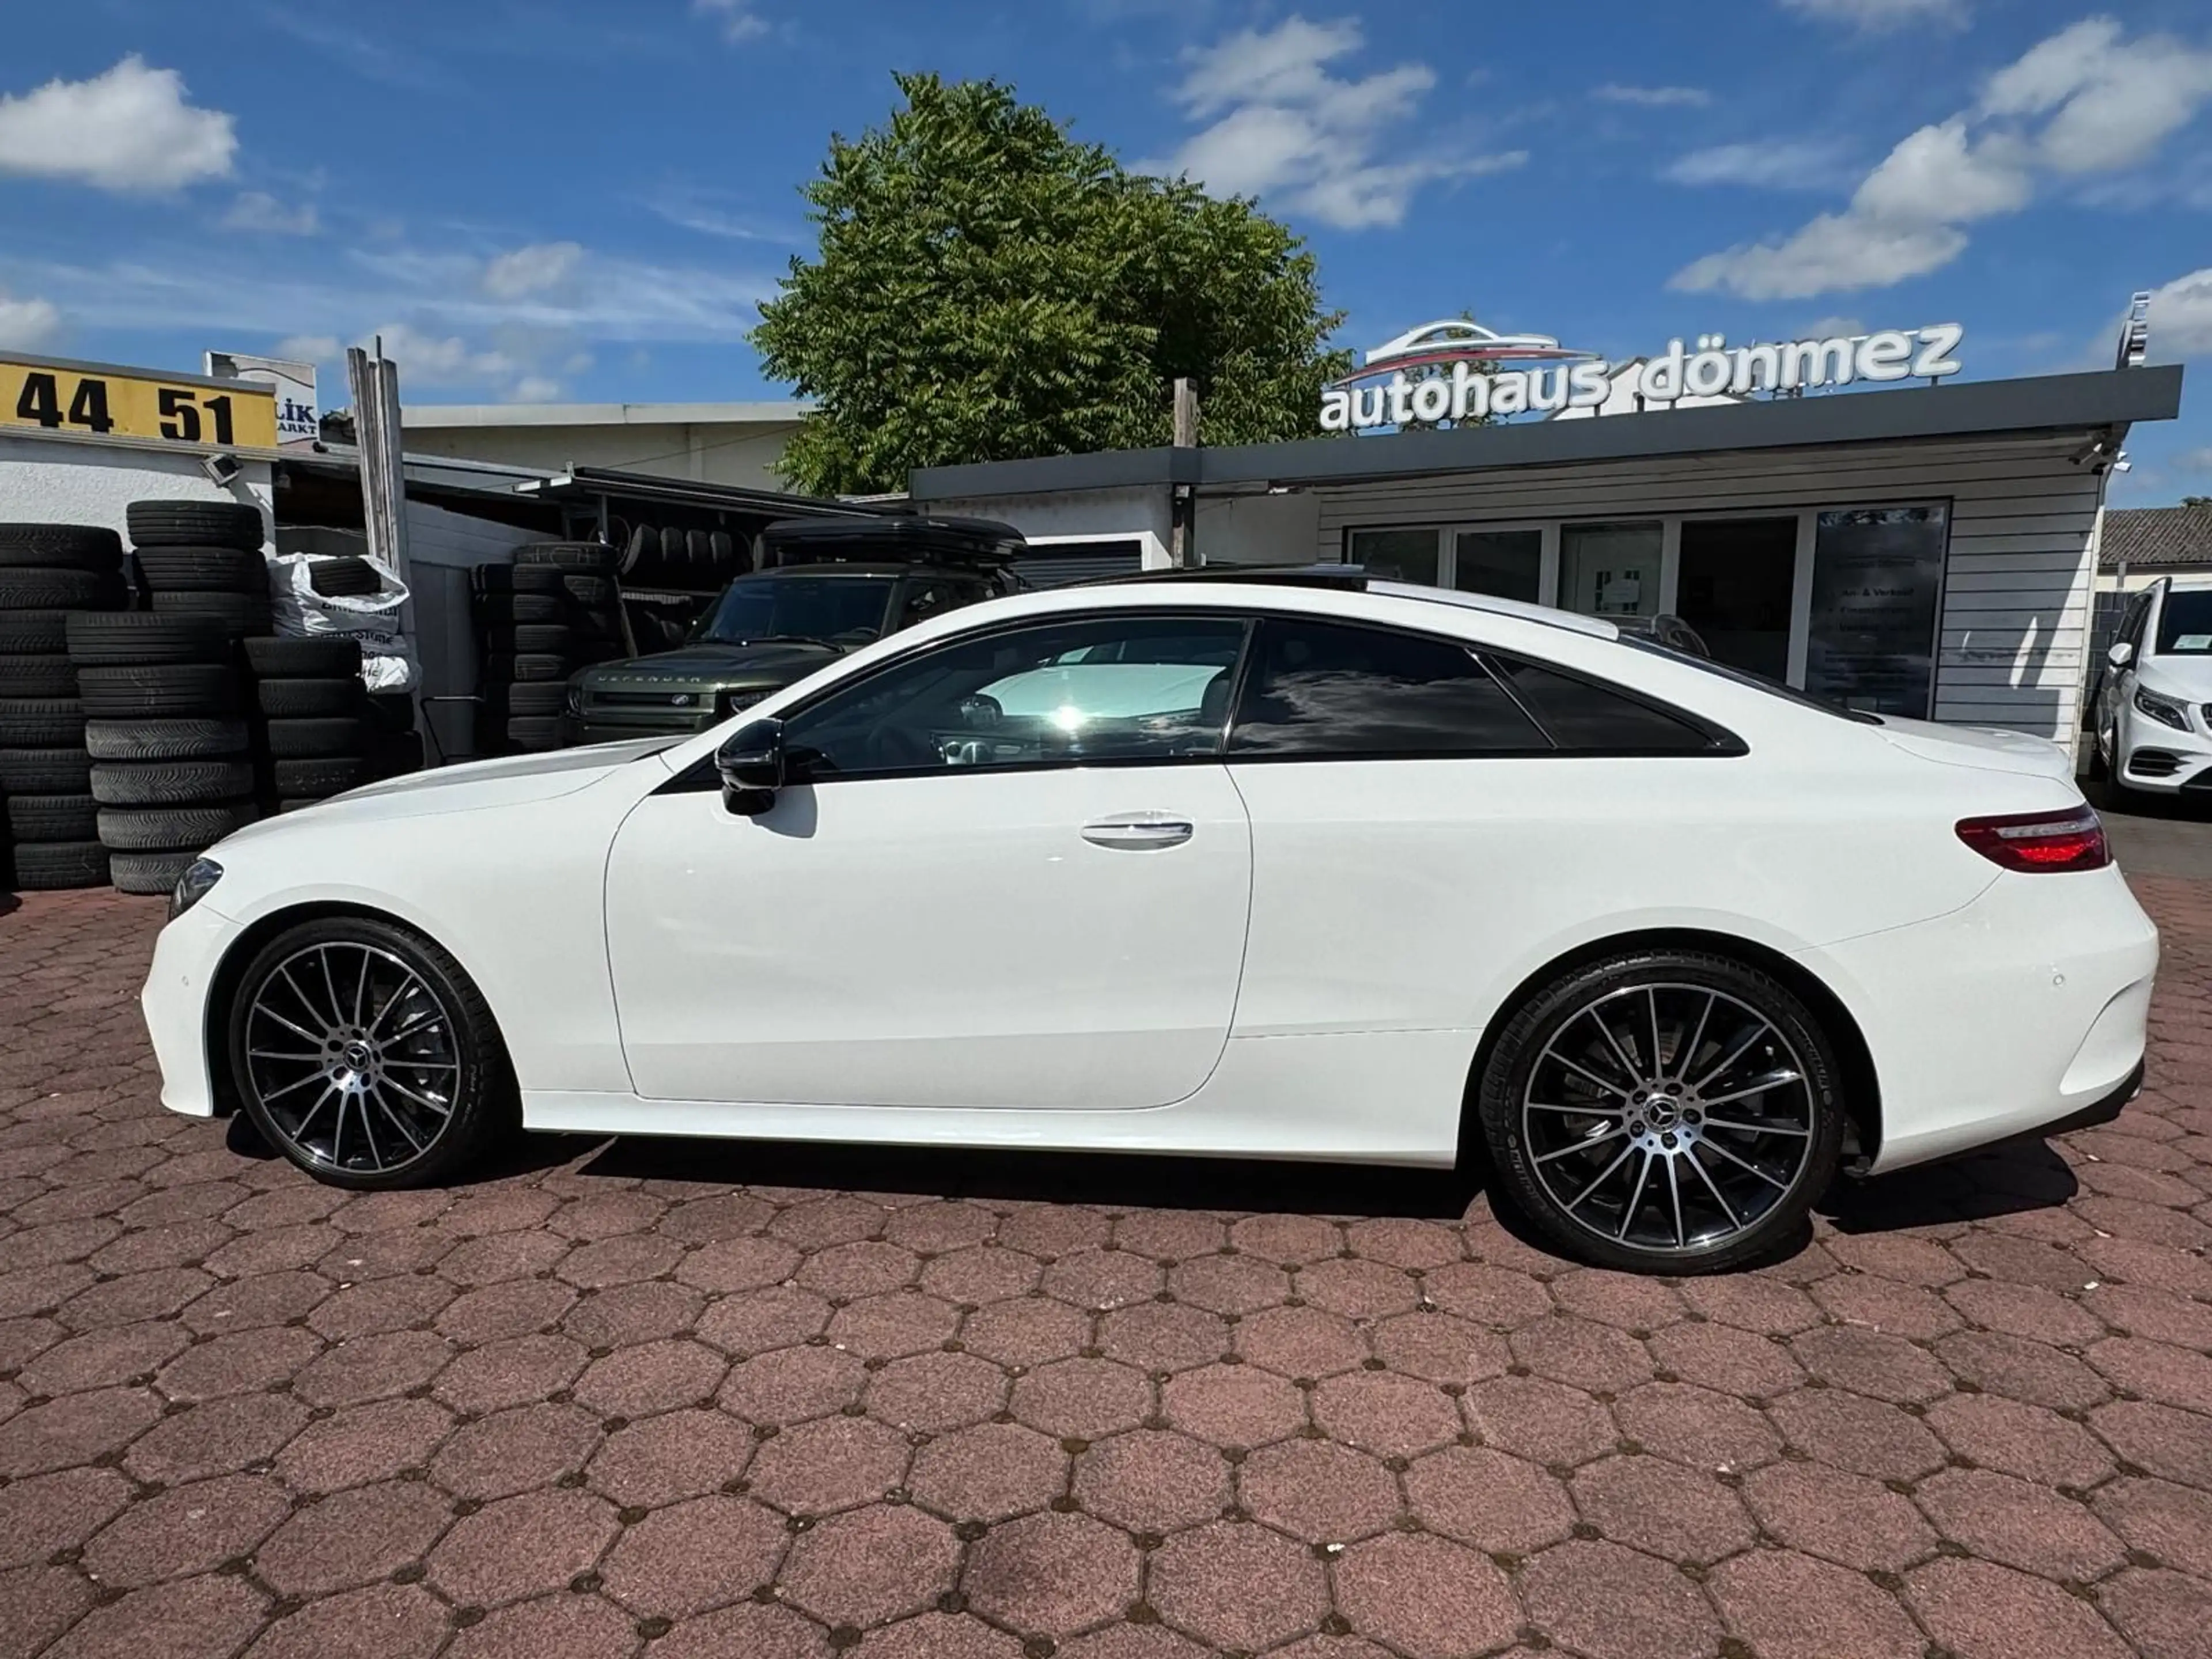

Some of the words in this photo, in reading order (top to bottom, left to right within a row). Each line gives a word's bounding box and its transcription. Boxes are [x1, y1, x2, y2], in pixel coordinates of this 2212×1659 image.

[17, 373, 114, 433] 44
[158, 388, 233, 445] 51
[1320, 361, 1611, 430] autohaus
[1638, 323, 1963, 402] dönmez
